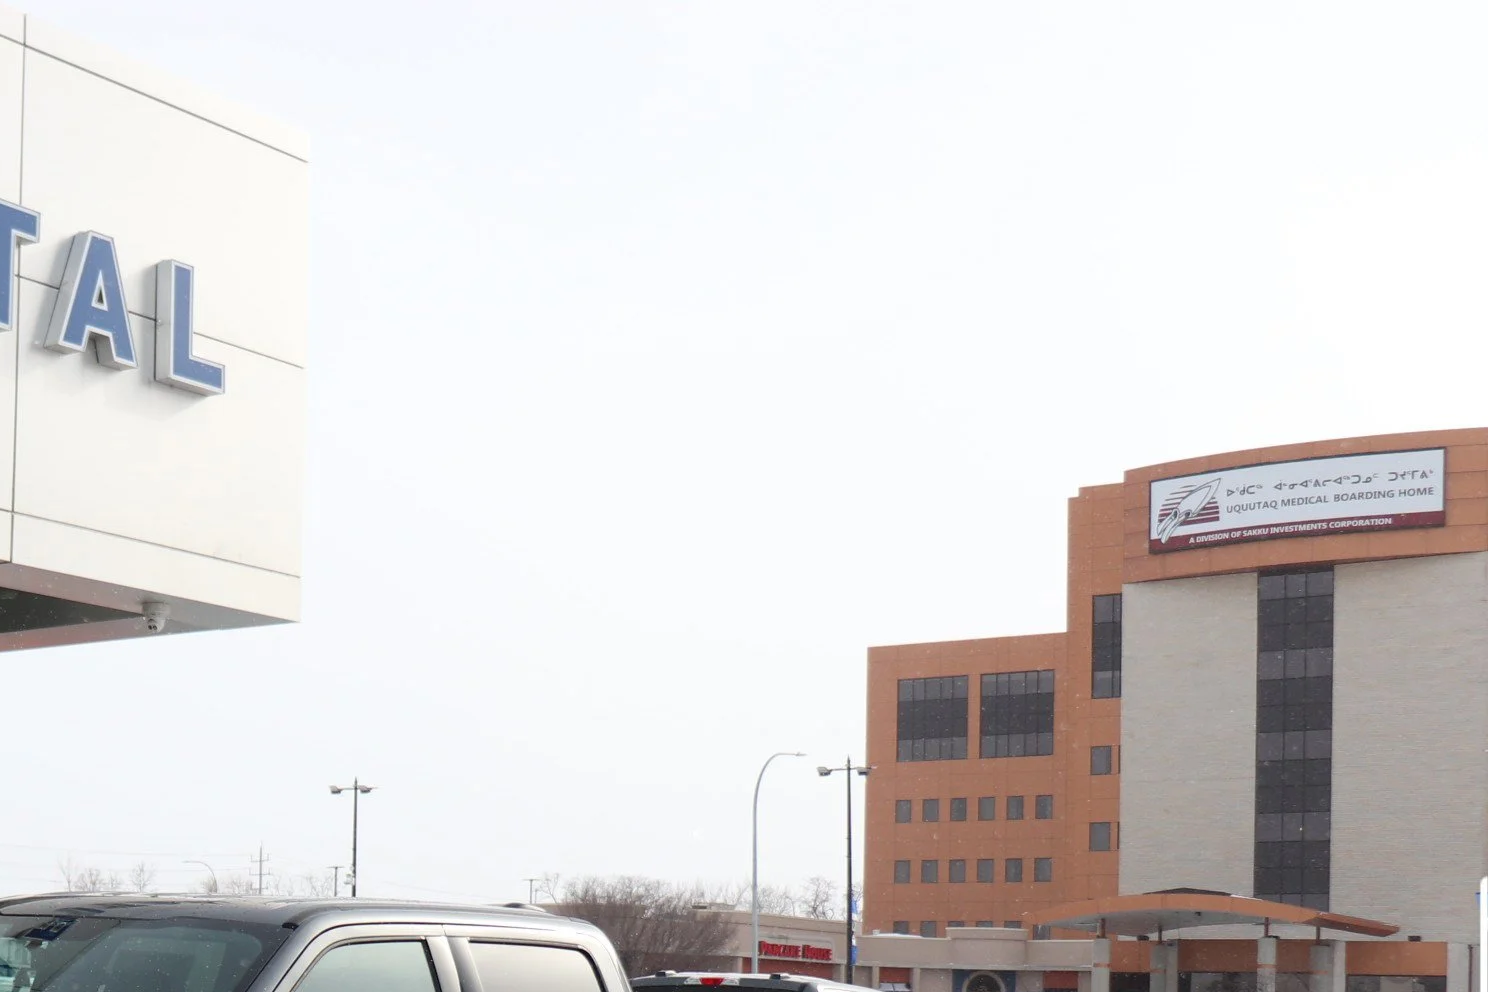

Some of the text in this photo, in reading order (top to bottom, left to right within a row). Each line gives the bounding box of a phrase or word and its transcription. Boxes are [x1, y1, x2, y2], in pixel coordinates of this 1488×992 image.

[1226, 486, 1435, 514] UQUUTAQ MEDICAL BOARDING HOME
[1196, 531, 1229, 543] DIVISION
[1230, 530, 1242, 539] OF
[1242, 527, 1269, 538] SAKKU
[1269, 522, 1328, 535] INVESTMENTS
[1328, 517, 1393, 530] CORPORATION
